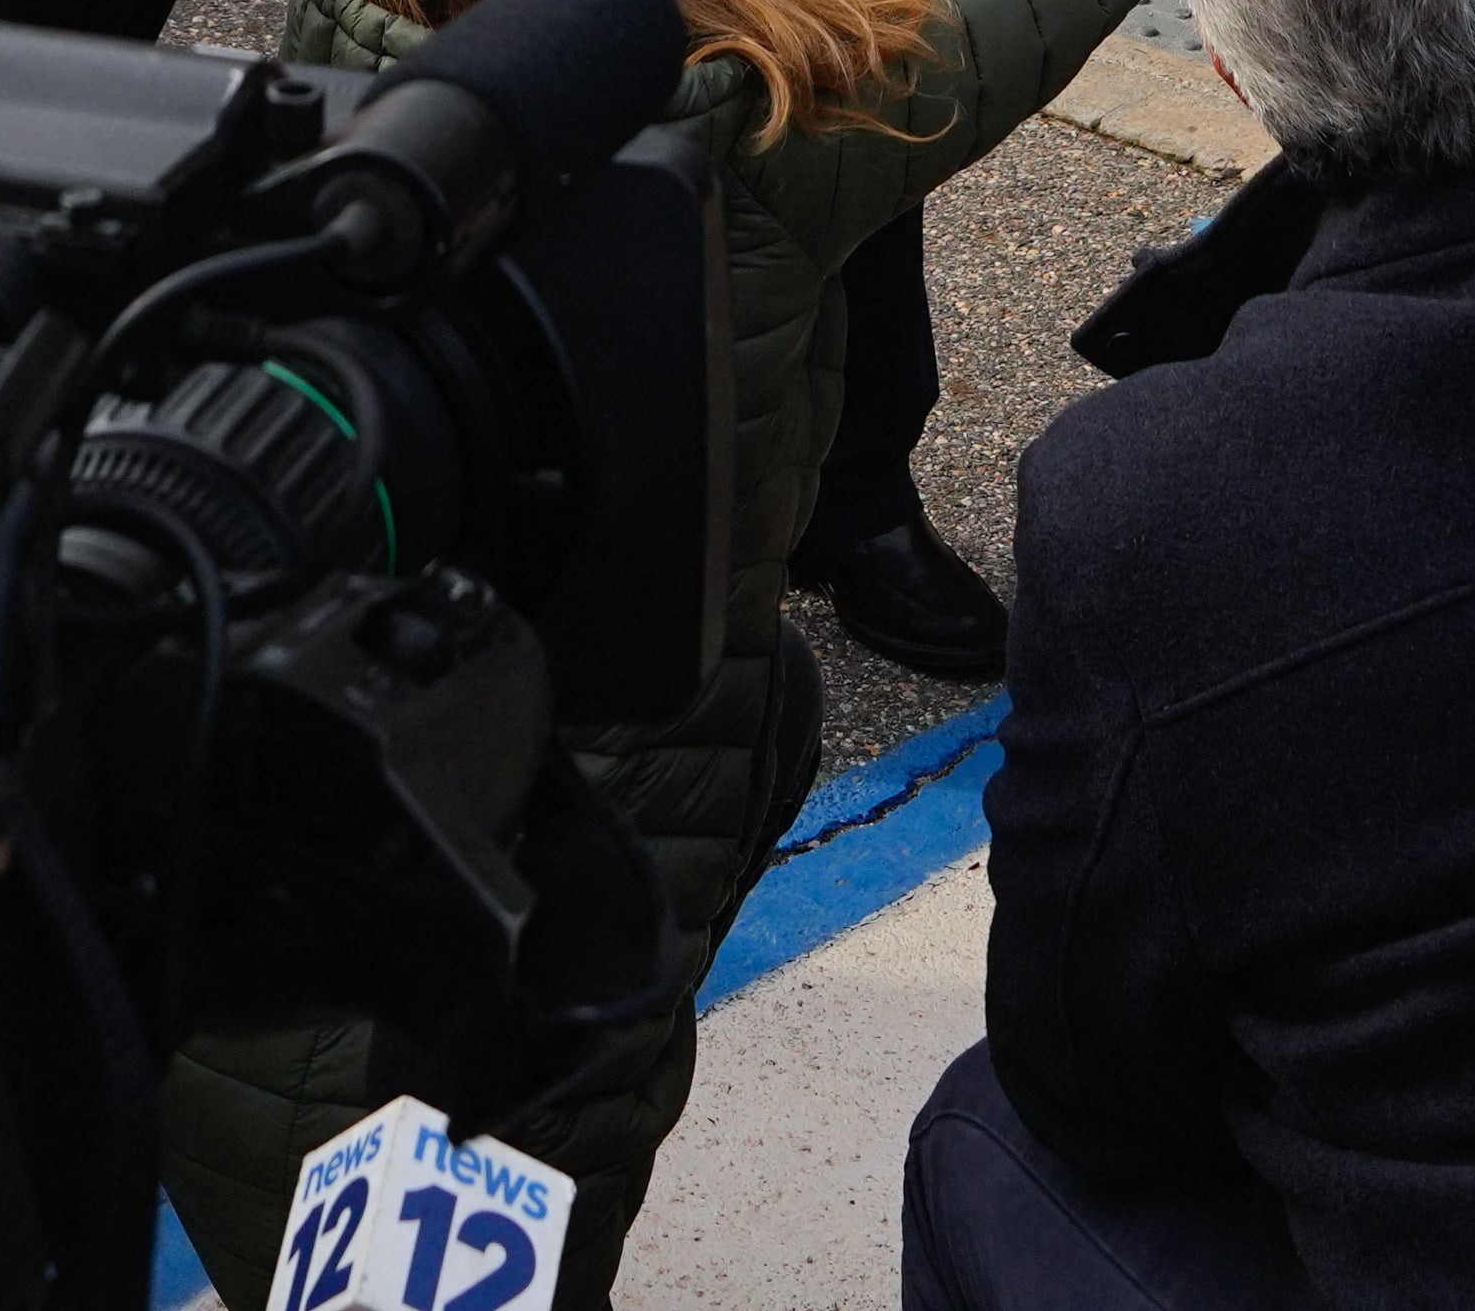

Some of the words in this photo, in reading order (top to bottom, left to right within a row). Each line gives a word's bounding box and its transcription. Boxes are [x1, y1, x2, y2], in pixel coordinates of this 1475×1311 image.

[303, 1123, 384, 1202] news
[414, 1124, 549, 1221] news
[286, 1177, 370, 1311] 12
[398, 1184, 537, 1311] 12
